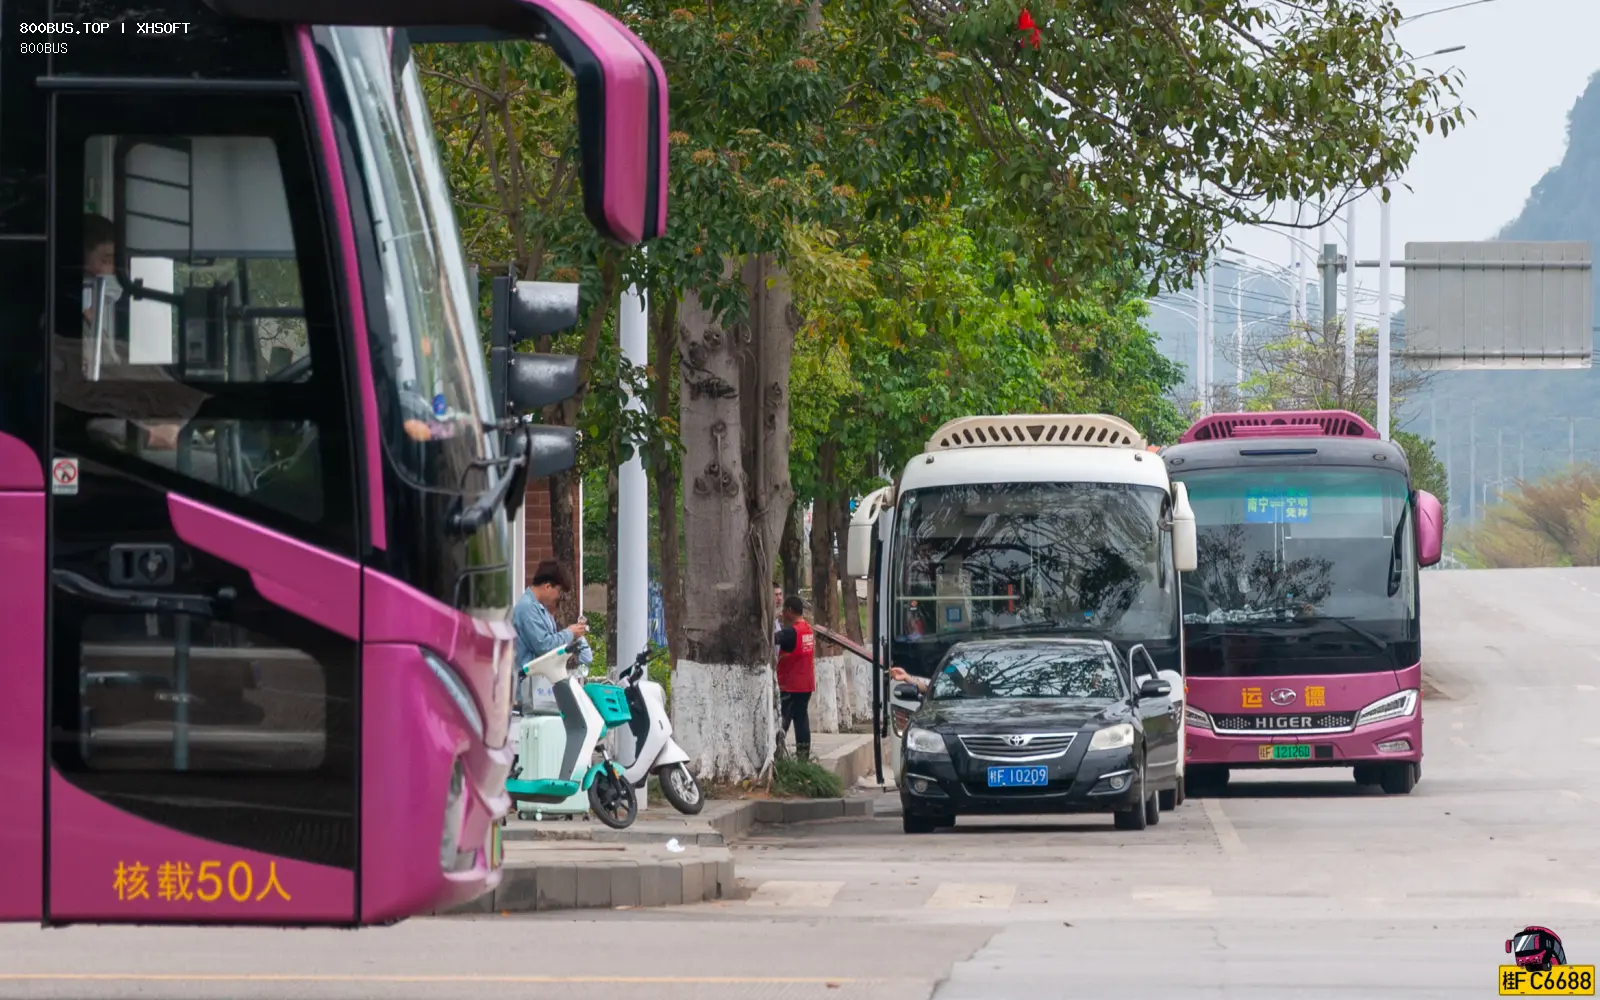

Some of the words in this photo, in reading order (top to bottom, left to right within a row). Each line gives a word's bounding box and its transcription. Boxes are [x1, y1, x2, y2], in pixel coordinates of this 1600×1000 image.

[1241, 687, 1263, 709] 运
[1255, 716, 1312, 729] HIGER
[112, 860, 292, 903] 核载50人
